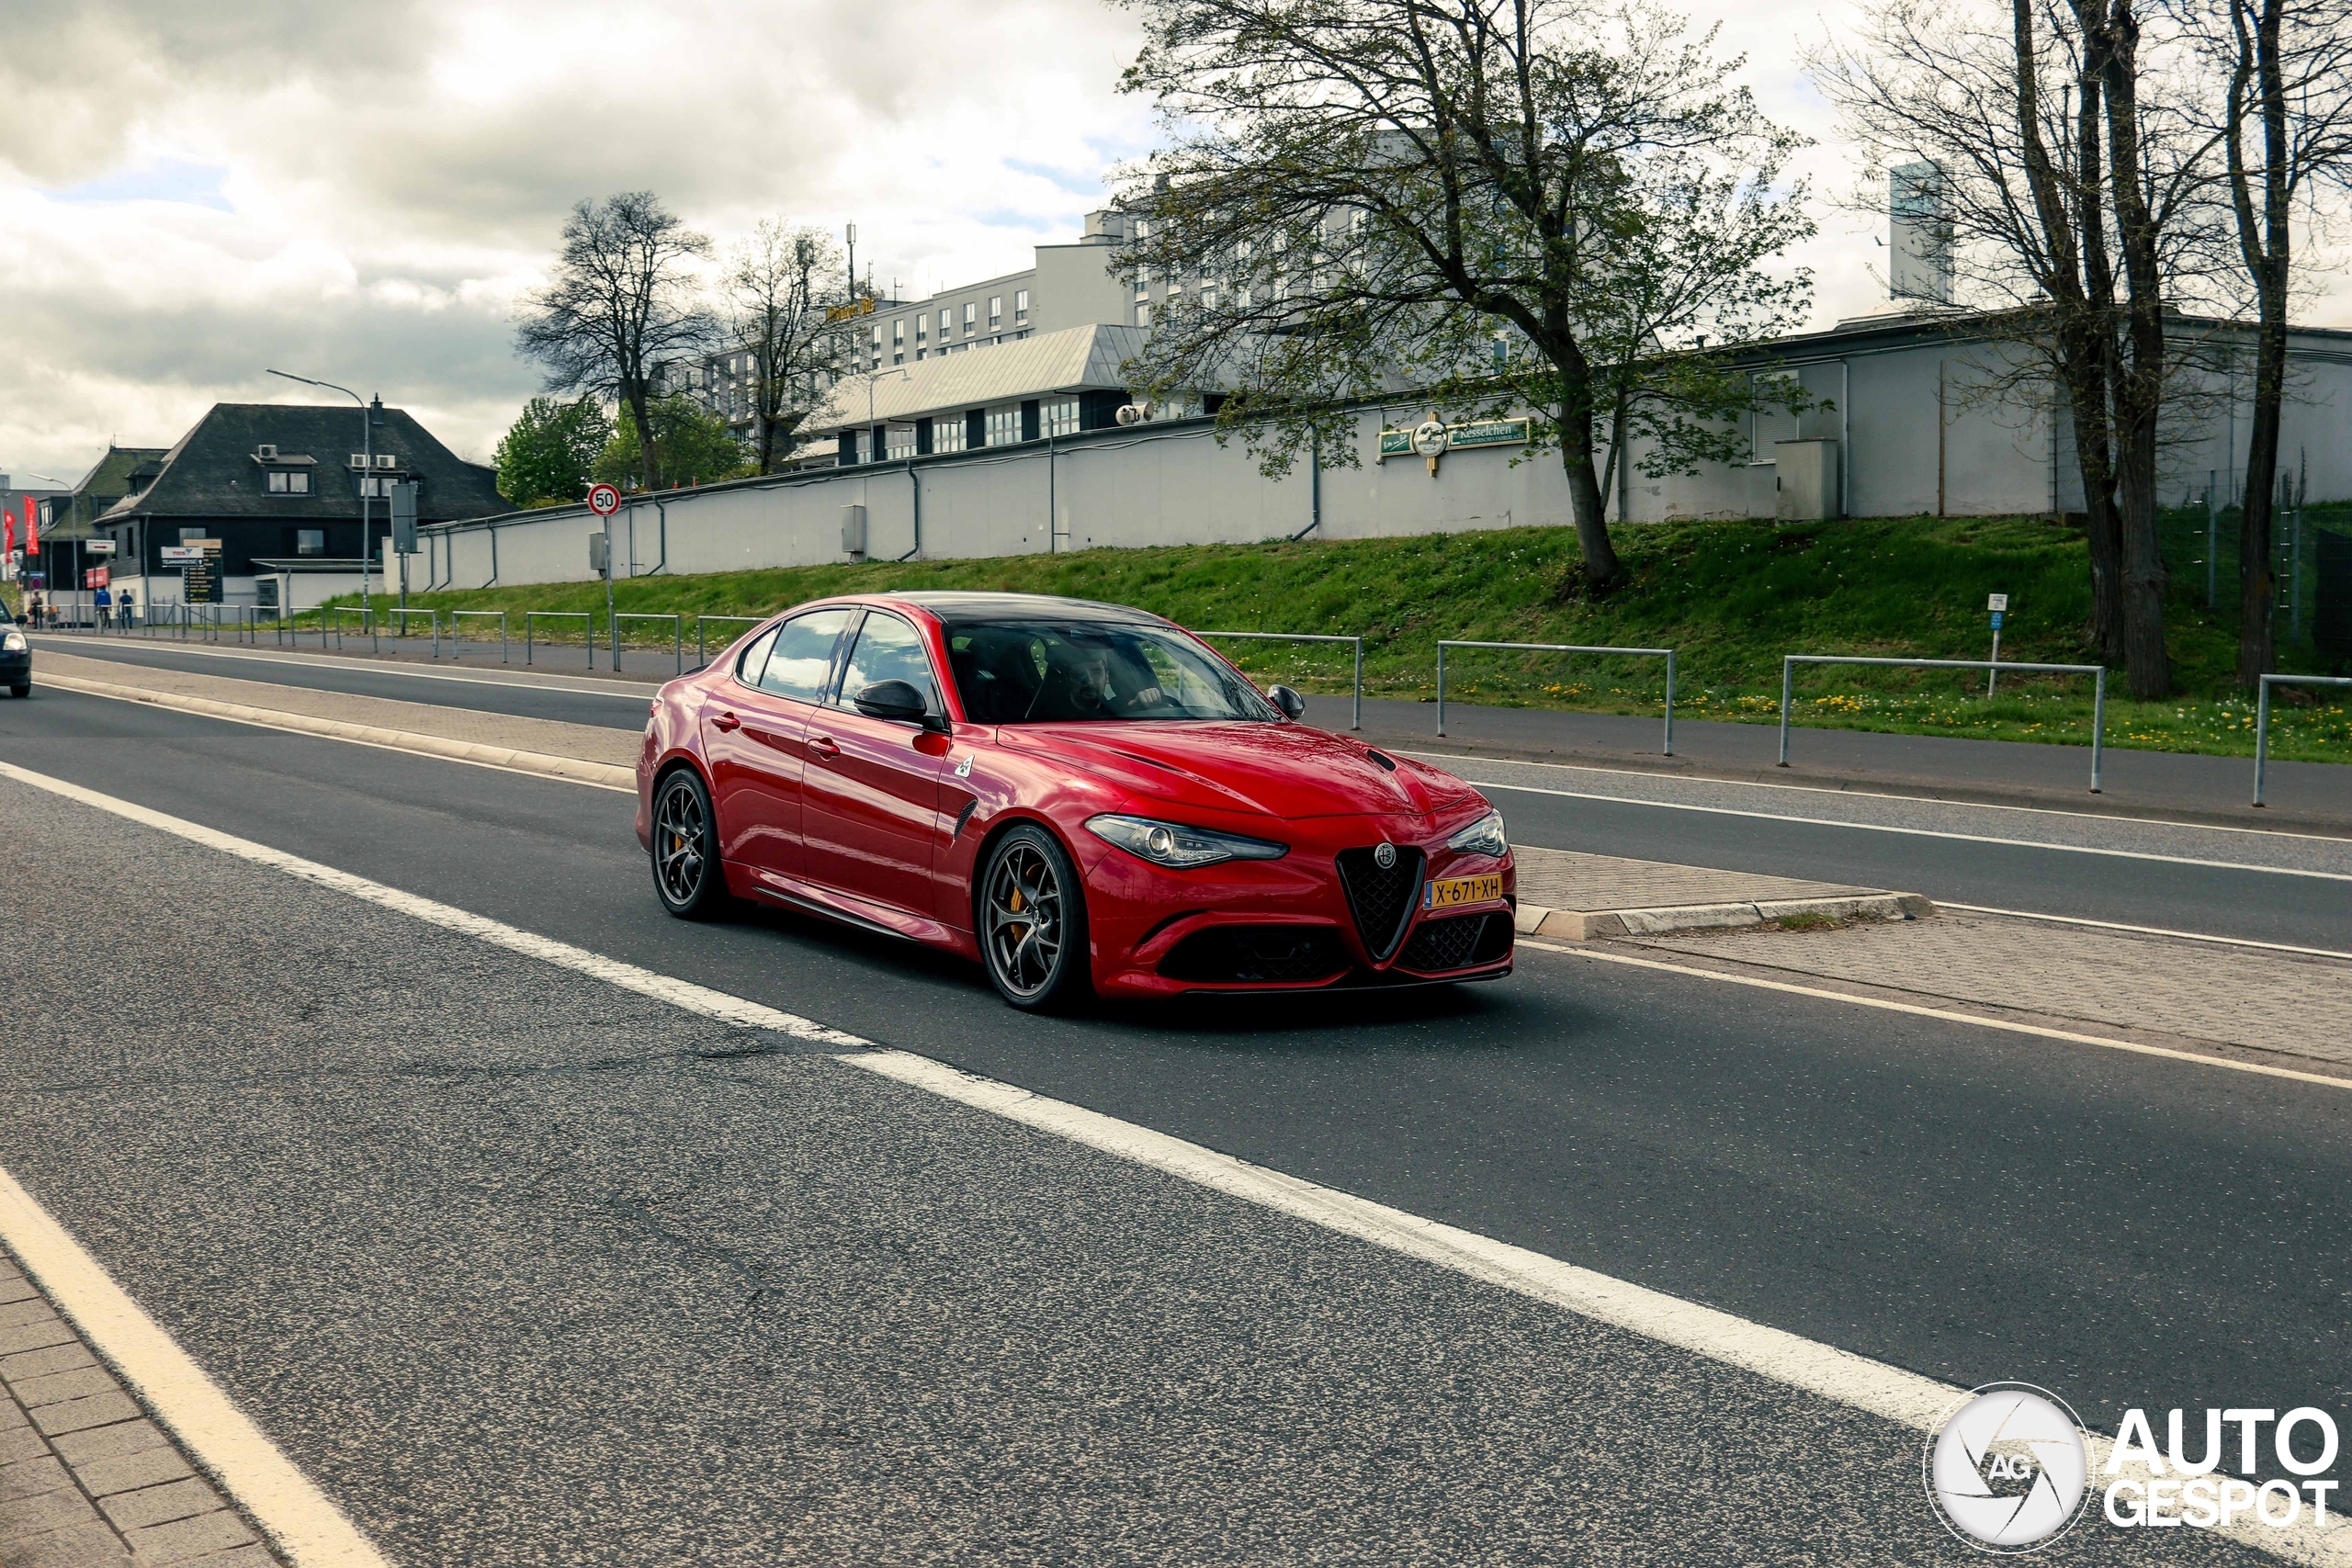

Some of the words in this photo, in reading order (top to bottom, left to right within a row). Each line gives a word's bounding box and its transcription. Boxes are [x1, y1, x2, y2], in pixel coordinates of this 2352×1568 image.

[1460, 424, 1511, 439] Kesselchen
[595, 492, 614, 507] 50
[1436, 878, 1498, 904] X-671-XH
